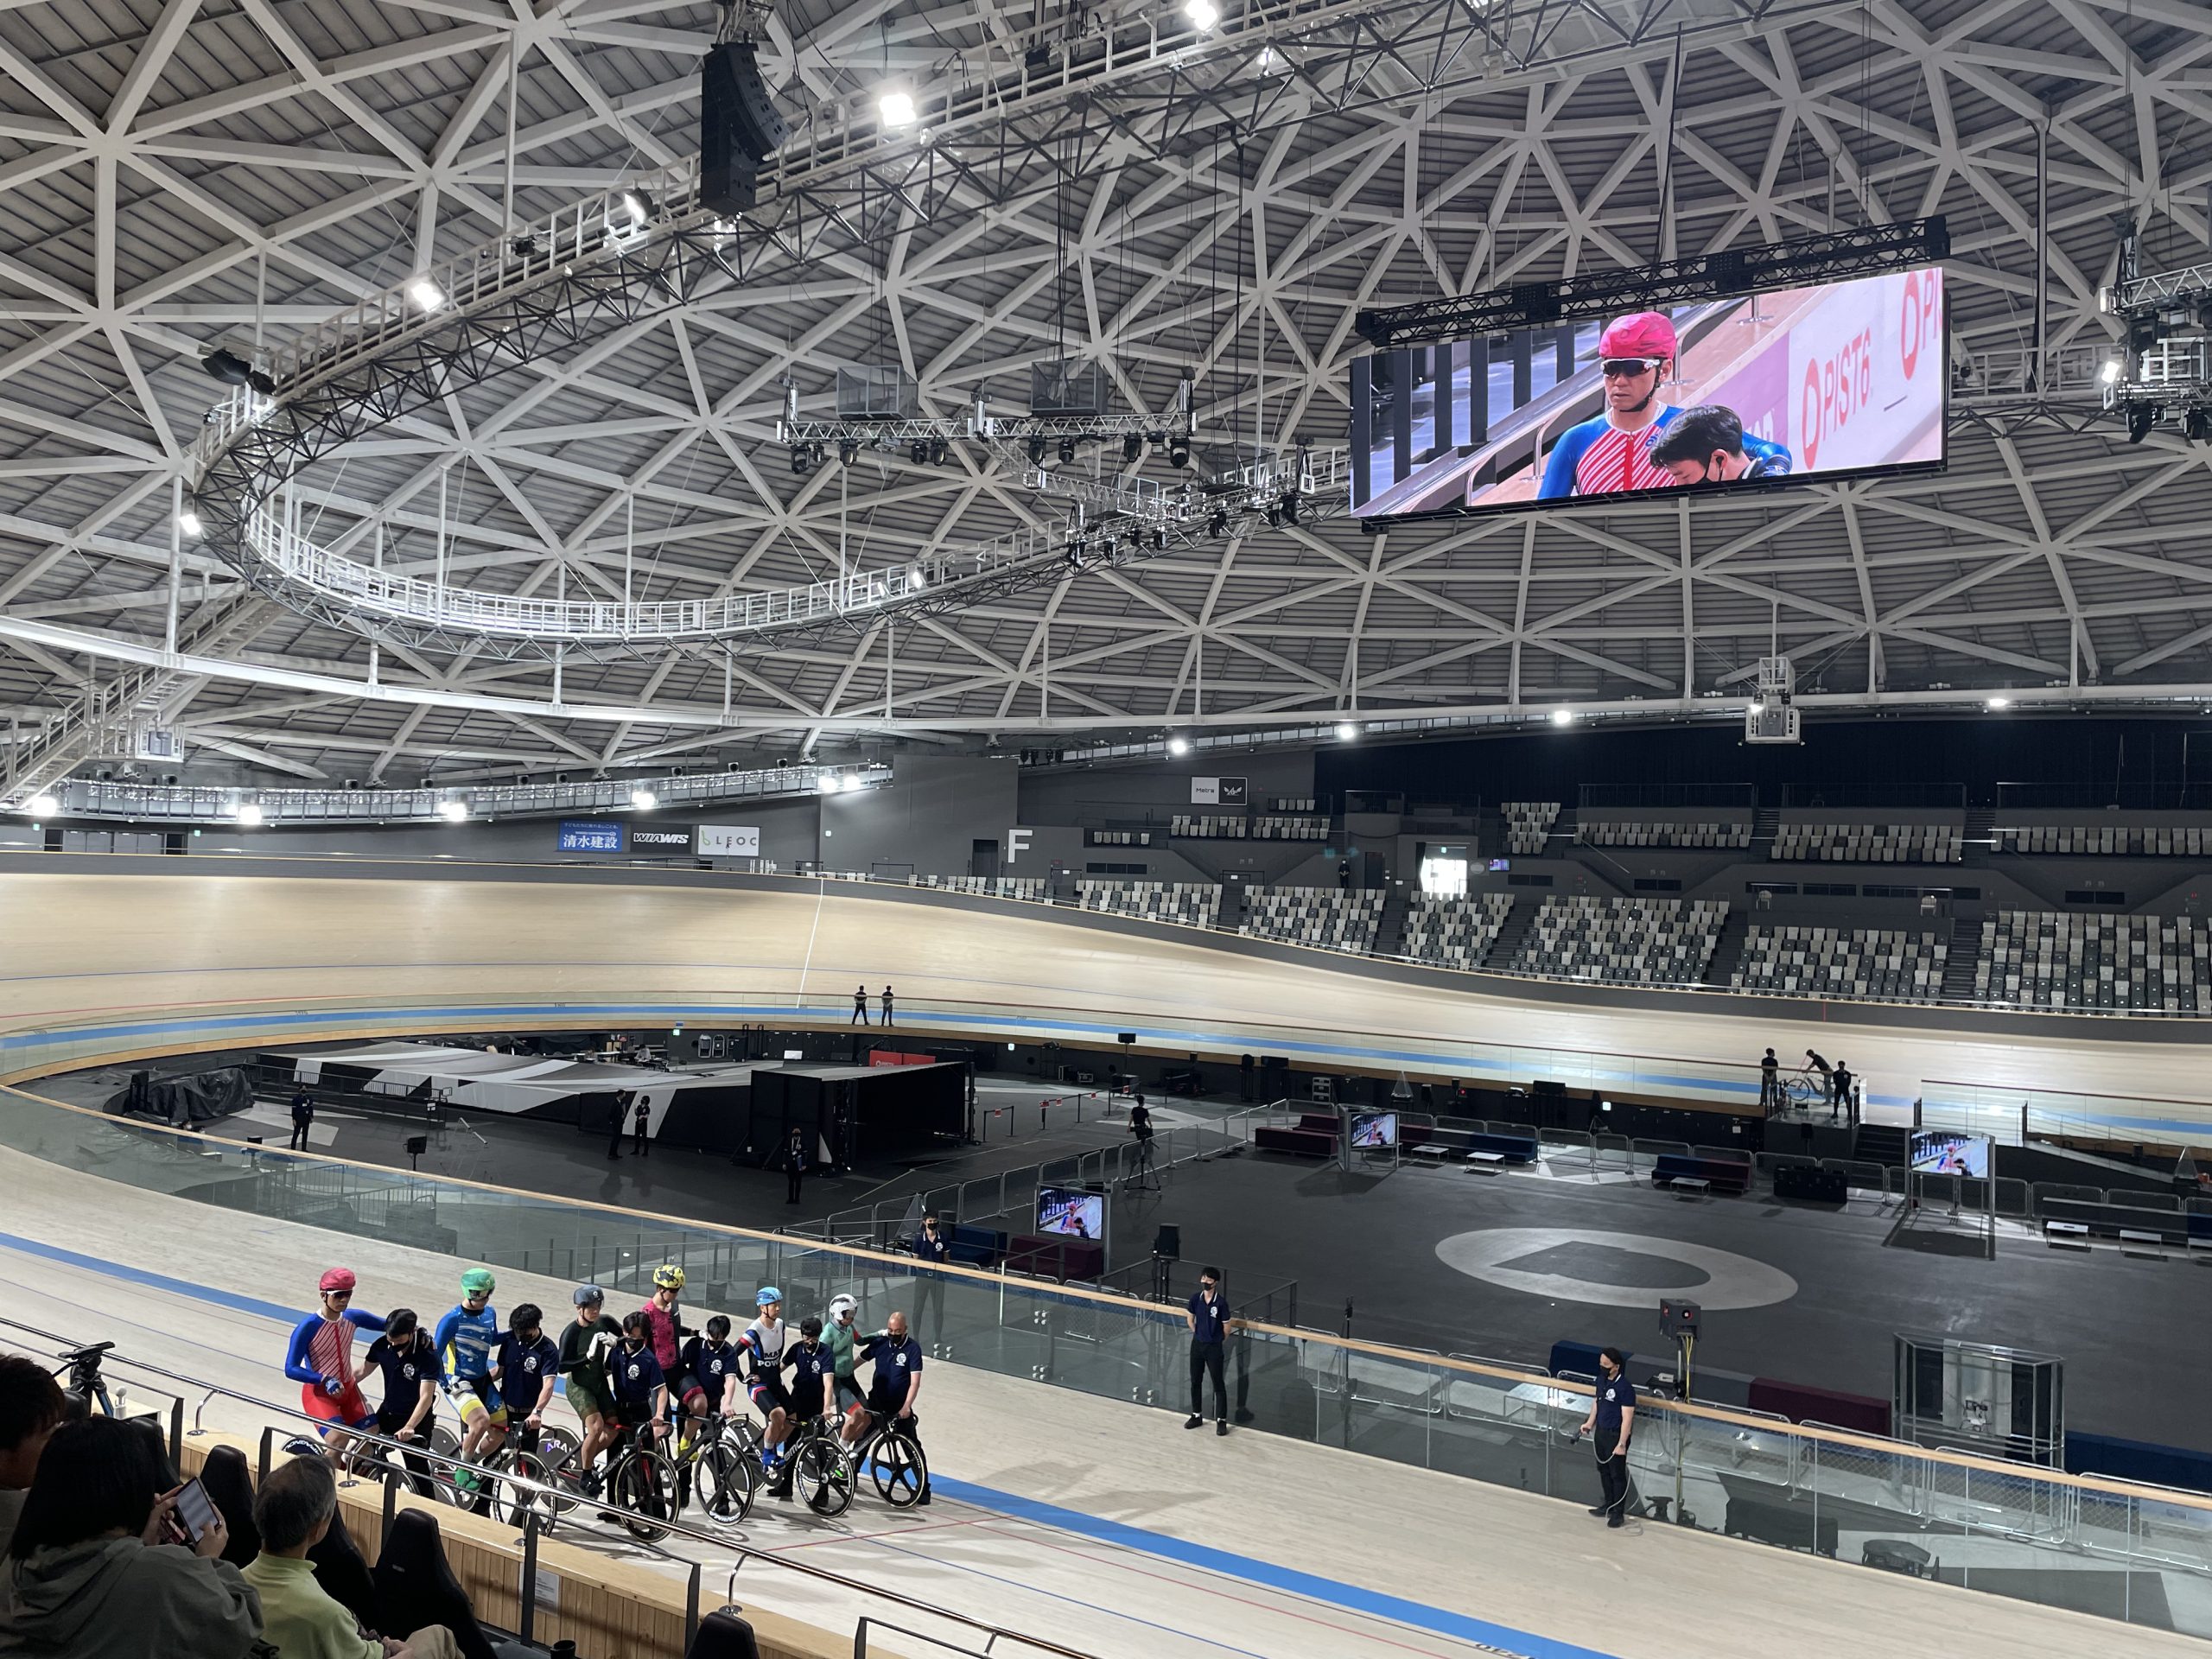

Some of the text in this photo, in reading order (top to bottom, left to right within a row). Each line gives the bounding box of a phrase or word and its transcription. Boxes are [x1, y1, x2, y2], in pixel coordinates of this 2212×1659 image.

[563, 834, 618, 849] 清水建設
[633, 832, 690, 845] WIAWIS
[1007, 829, 1033, 863] F
